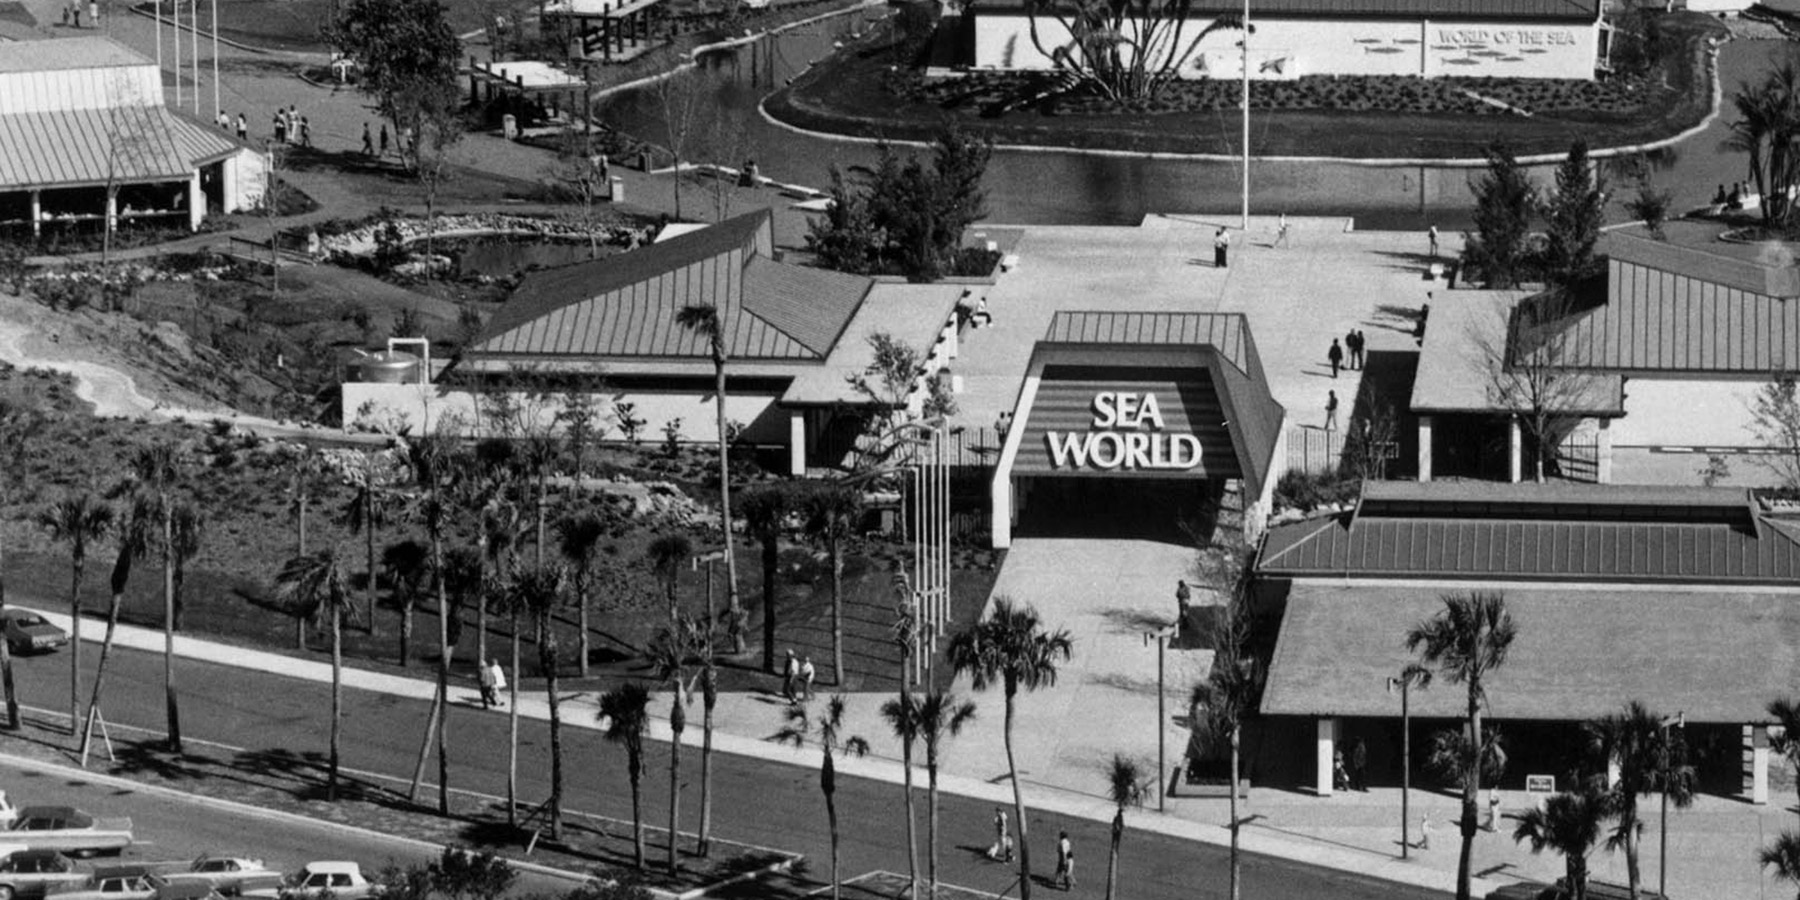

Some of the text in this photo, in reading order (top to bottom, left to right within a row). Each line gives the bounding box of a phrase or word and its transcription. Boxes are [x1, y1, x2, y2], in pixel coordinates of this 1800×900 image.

[1438, 30, 1576, 46] WORLD OF THE SEA
[1092, 391, 1165, 429] SEA
[1046, 431, 1203, 469] WORLD
